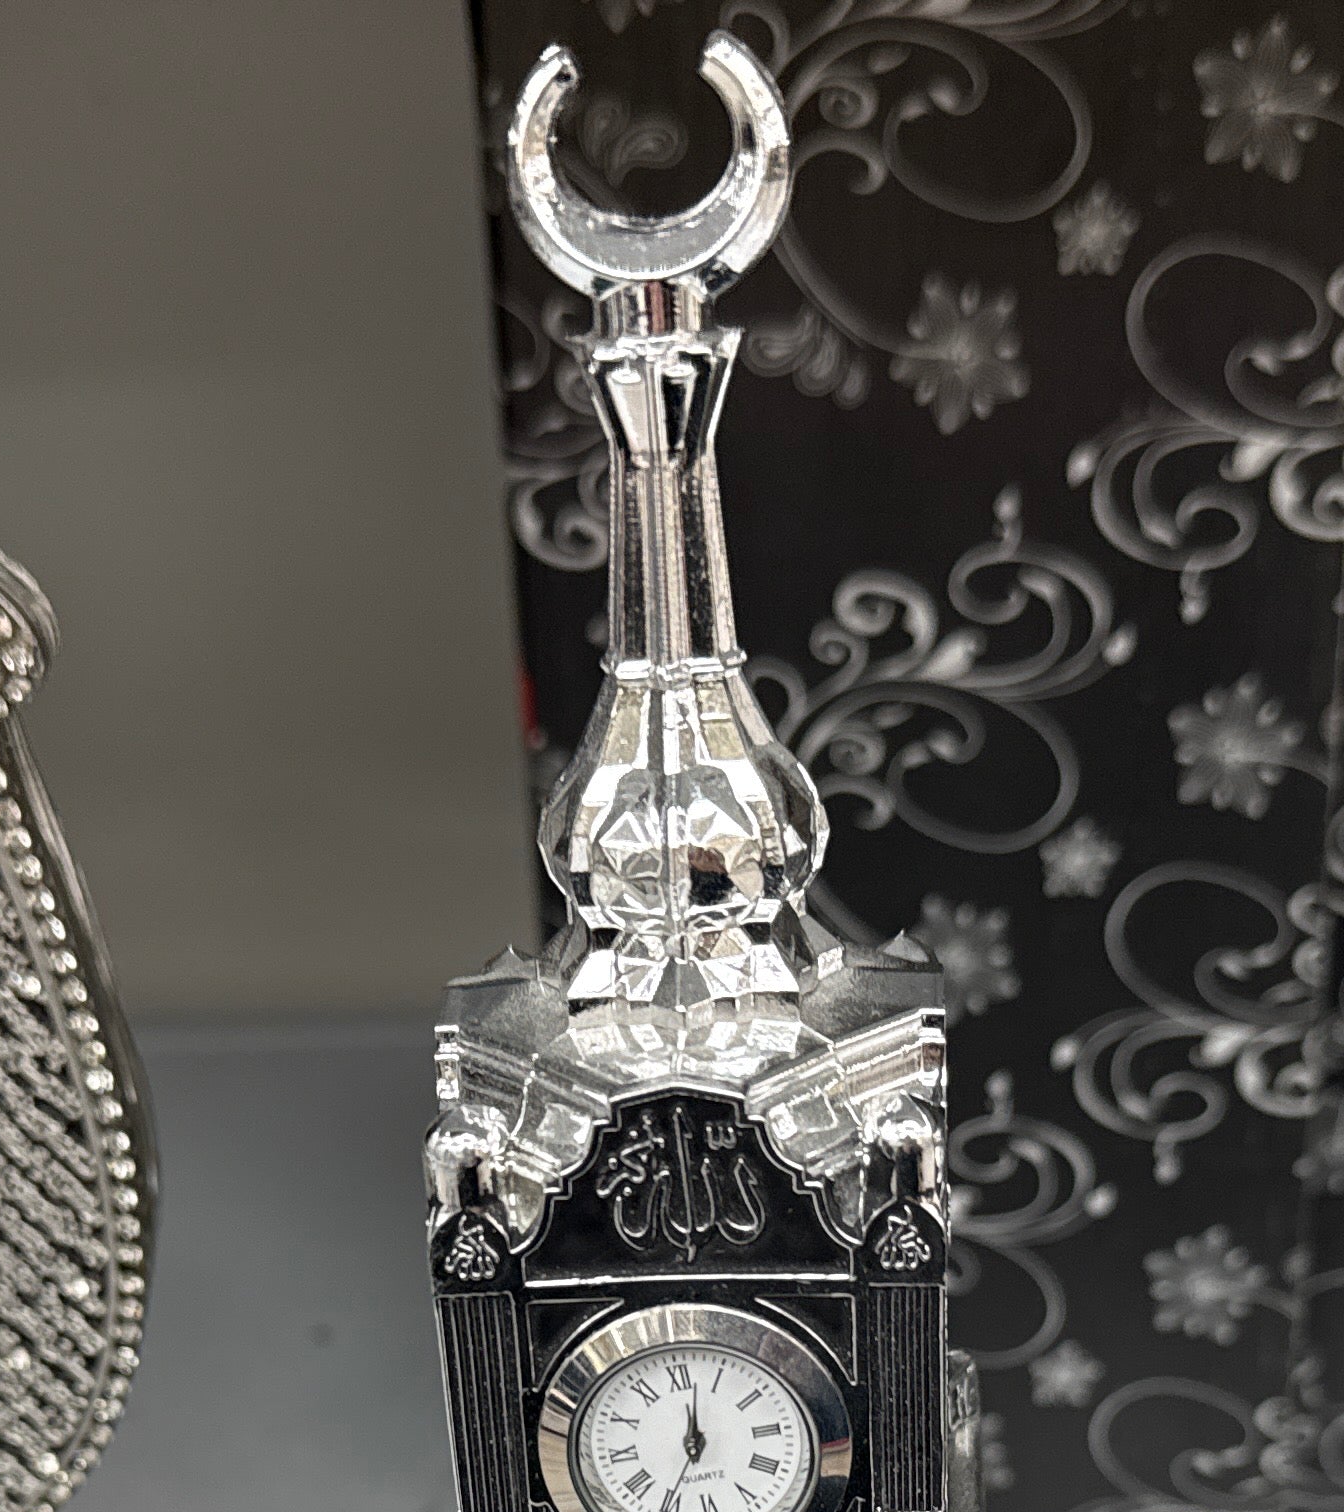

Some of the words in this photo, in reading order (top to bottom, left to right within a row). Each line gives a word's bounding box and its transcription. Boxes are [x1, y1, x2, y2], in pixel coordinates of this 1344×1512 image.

[665, 1364, 692, 1393] XII
[711, 1368, 724, 1393] I
[630, 1378, 661, 1408] XI
[736, 1388, 764, 1412] II
[610, 1410, 640, 1430] X
[751, 1422, 781, 1439] III
[608, 1444, 639, 1464] IX
[748, 1452, 780, 1476] IIII
[623, 1467, 656, 1500] VIII
[681, 1469, 726, 1485] QUARTZ
[734, 1482, 758, 1505] V
